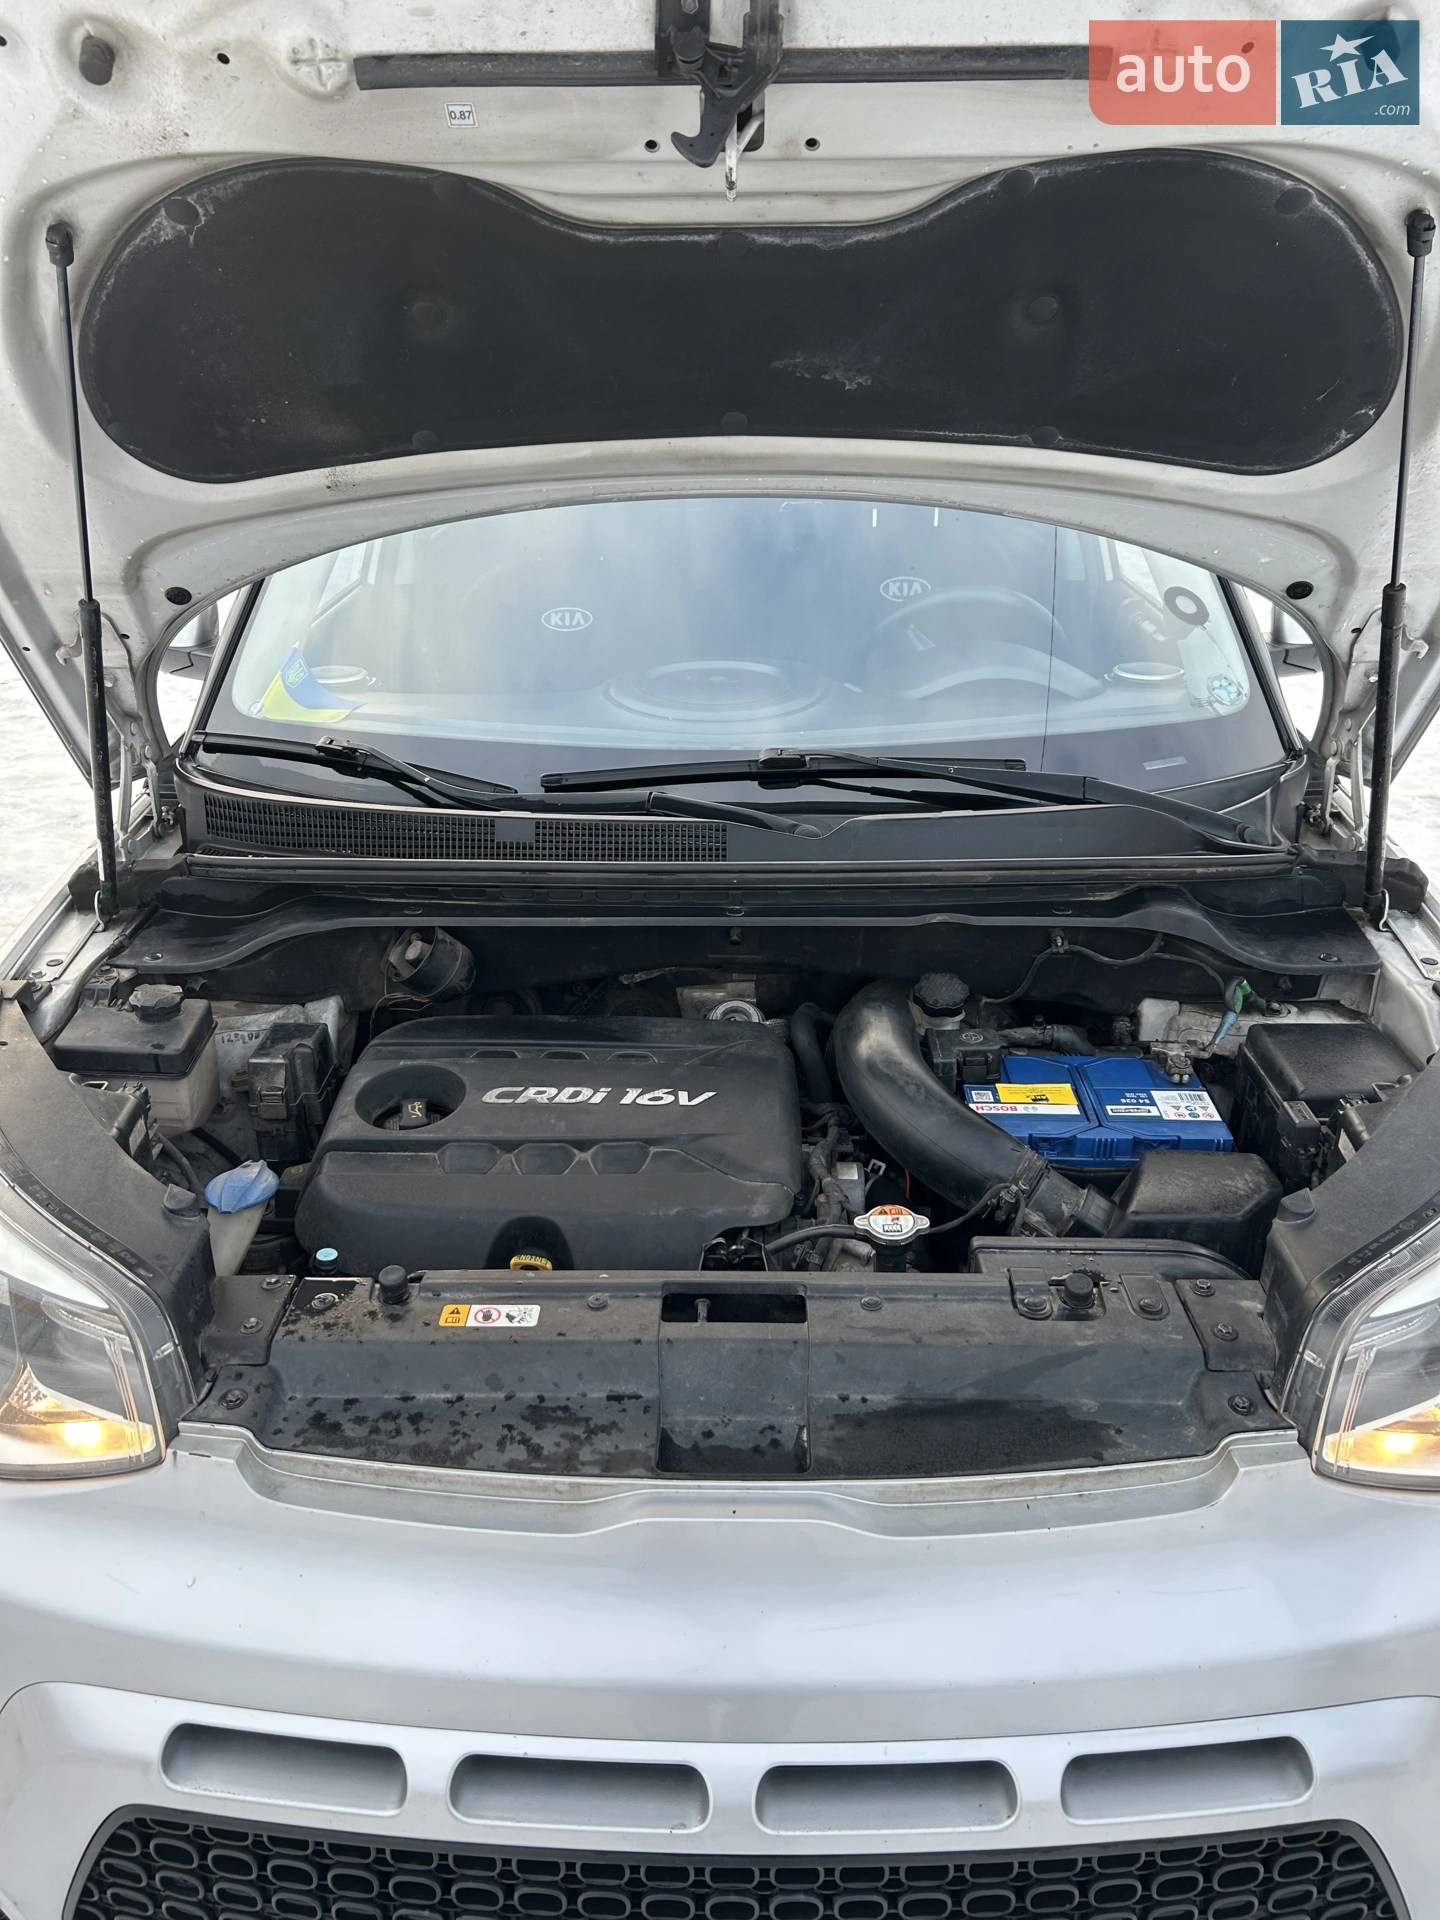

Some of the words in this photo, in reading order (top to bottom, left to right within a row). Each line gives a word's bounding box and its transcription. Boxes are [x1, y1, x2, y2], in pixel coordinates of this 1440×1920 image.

[449, 110, 472, 121] 0.87
[888, 581, 922, 597] KIA
[549, 611, 586, 627] KIA
[481, 1086, 612, 1105] CRDi
[619, 1087, 717, 1106] 16V
